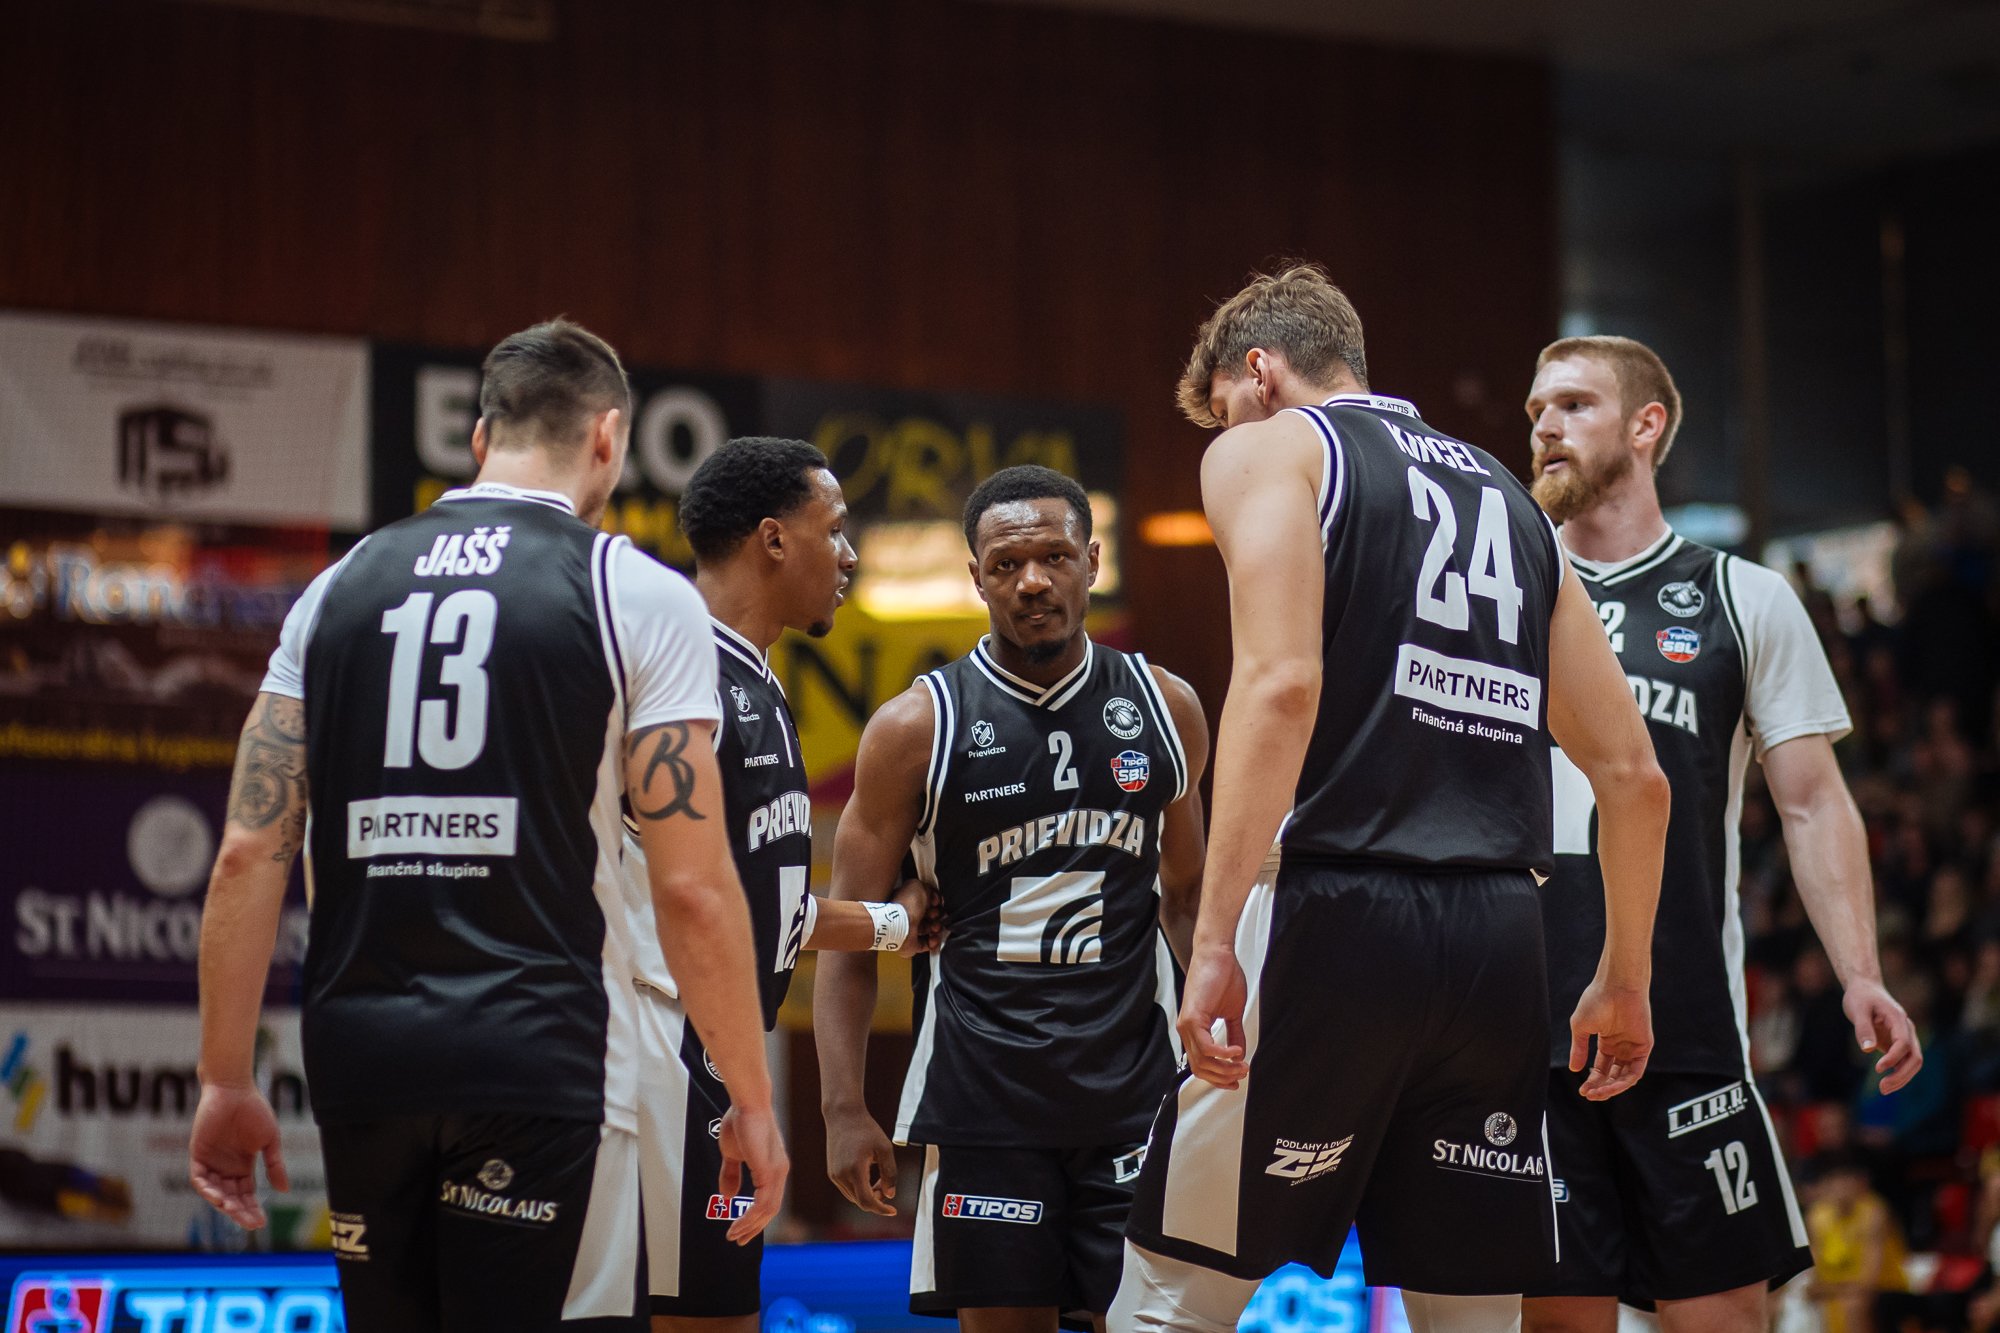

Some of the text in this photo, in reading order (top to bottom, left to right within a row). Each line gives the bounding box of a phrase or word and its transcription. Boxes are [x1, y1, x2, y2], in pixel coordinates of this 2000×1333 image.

[1387, 402, 1409, 414] ATTIS
[414, 526, 512, 577] JAŠŠ
[1407, 465, 1523, 645] 24
[1593, 600, 1627, 653] 2
[380, 588, 499, 770] 13
[1408, 659, 1530, 711] PARTNERS
[1412, 706, 1523, 745] Finančná skupina
[744, 753, 779, 768] PARTNERS
[968, 746, 1007, 759] Prievidza
[1047, 730, 1080, 792] 2
[1122, 758, 1148, 767] TIPOS
[1118, 768, 1147, 783] SBL
[964, 782, 1027, 803] PARTNERS
[359, 812, 500, 842] PARTNERS
[977, 808, 1146, 877] PRIEVIDZA
[426, 863, 490, 880] skupina
[1275, 1138, 1322, 1151] PODLAHY
[1322, 1142, 1330, 1151] A
[1703, 1140, 1759, 1216] 12
[966, 1199, 1038, 1221] TIPOS
